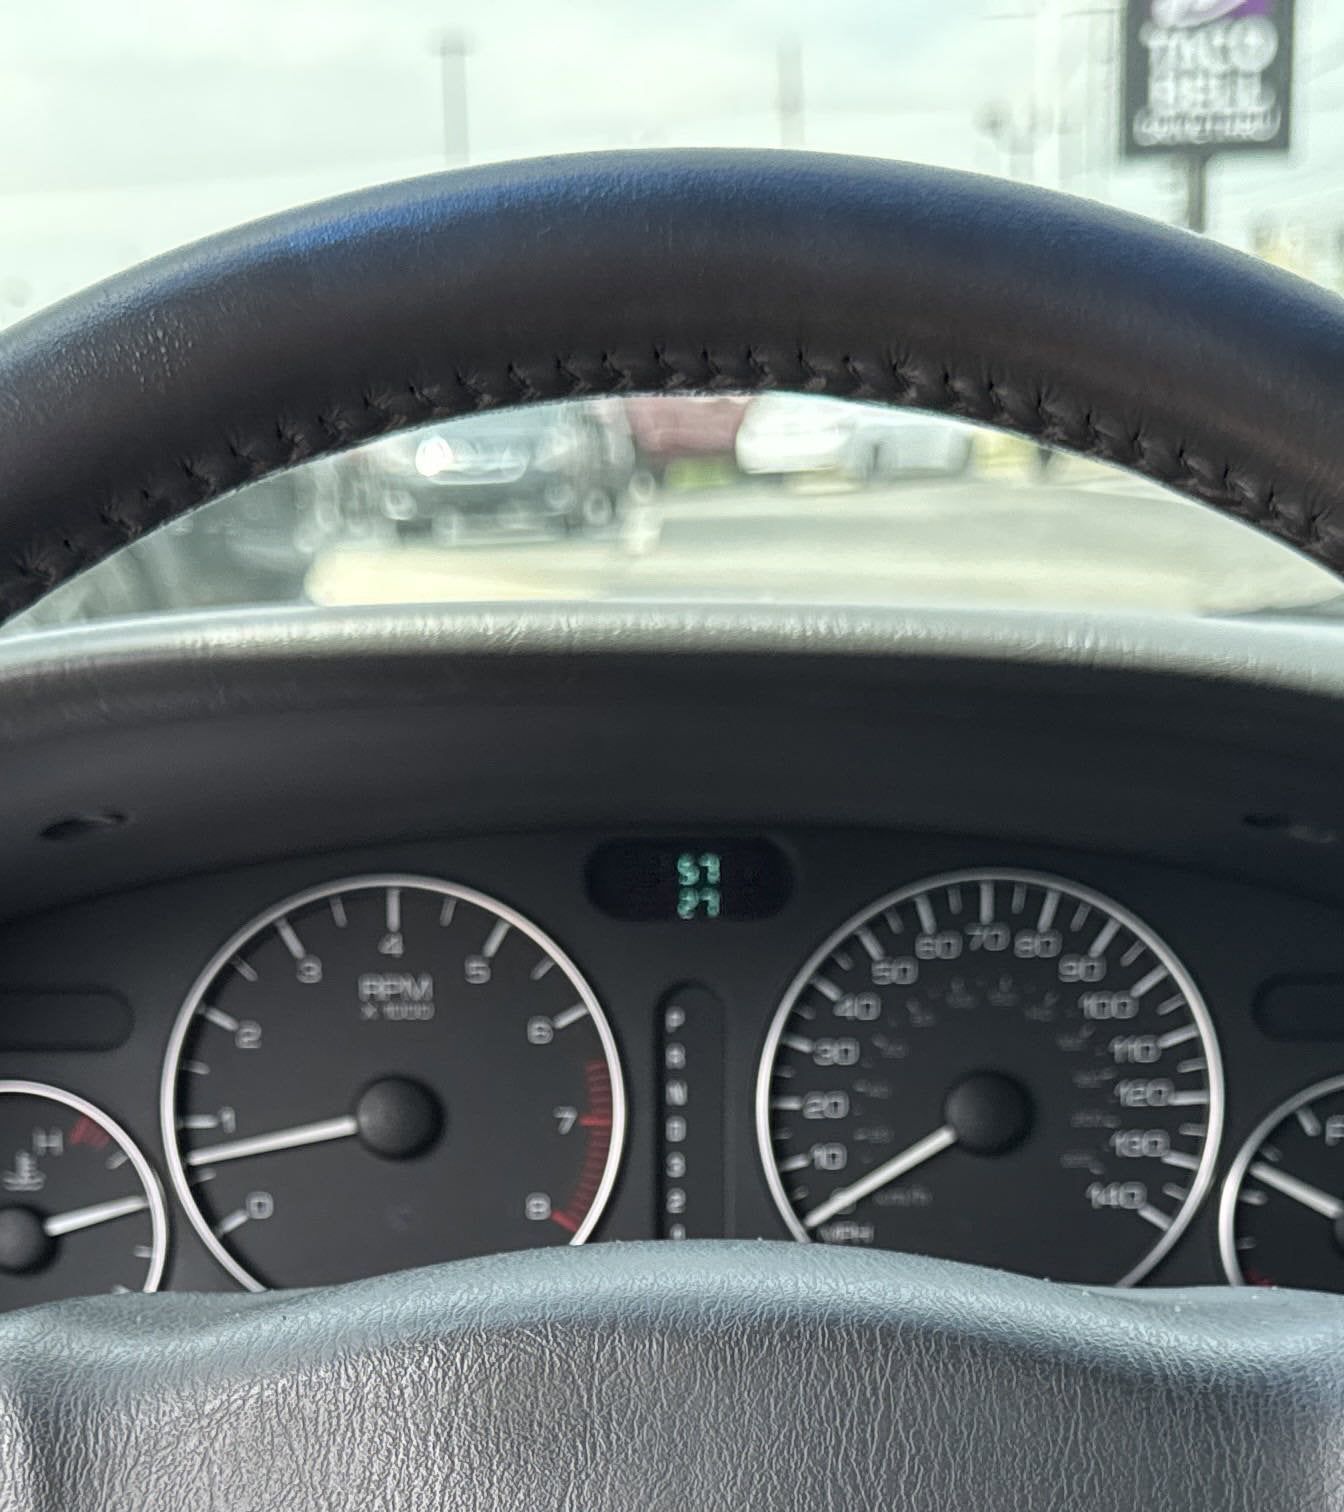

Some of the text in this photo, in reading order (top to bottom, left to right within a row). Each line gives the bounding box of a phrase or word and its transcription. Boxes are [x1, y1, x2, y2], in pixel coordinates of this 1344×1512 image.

[378, 931, 404, 958] 4
[915, 930, 962, 960] 60
[965, 922, 1011, 951] 70
[1013, 929, 1062, 958] 80
[296, 953, 323, 984] 3
[464, 953, 491, 985] 5
[871, 956, 919, 985] 50
[1058, 953, 1106, 982] 90
[358, 972, 434, 1001] RPM
[833, 992, 881, 1021] 40
[1078, 989, 1139, 1020] 100
[235, 1020, 262, 1049] 2
[526, 1016, 554, 1045] 6
[812, 1037, 860, 1066] 30
[1109, 1033, 1162, 1064] 110
[802, 1090, 849, 1120] 20
[1115, 1078, 1175, 1107] 120
[218, 1106, 237, 1134] 1
[554, 1106, 577, 1135] 7
[32, 1126, 63, 1156] H
[809, 1141, 847, 1170] 10
[1109, 1128, 1171, 1158] 130
[246, 1191, 274, 1220] 0
[524, 1192, 552, 1221] 8
[1086, 1180, 1148, 1210] 140
